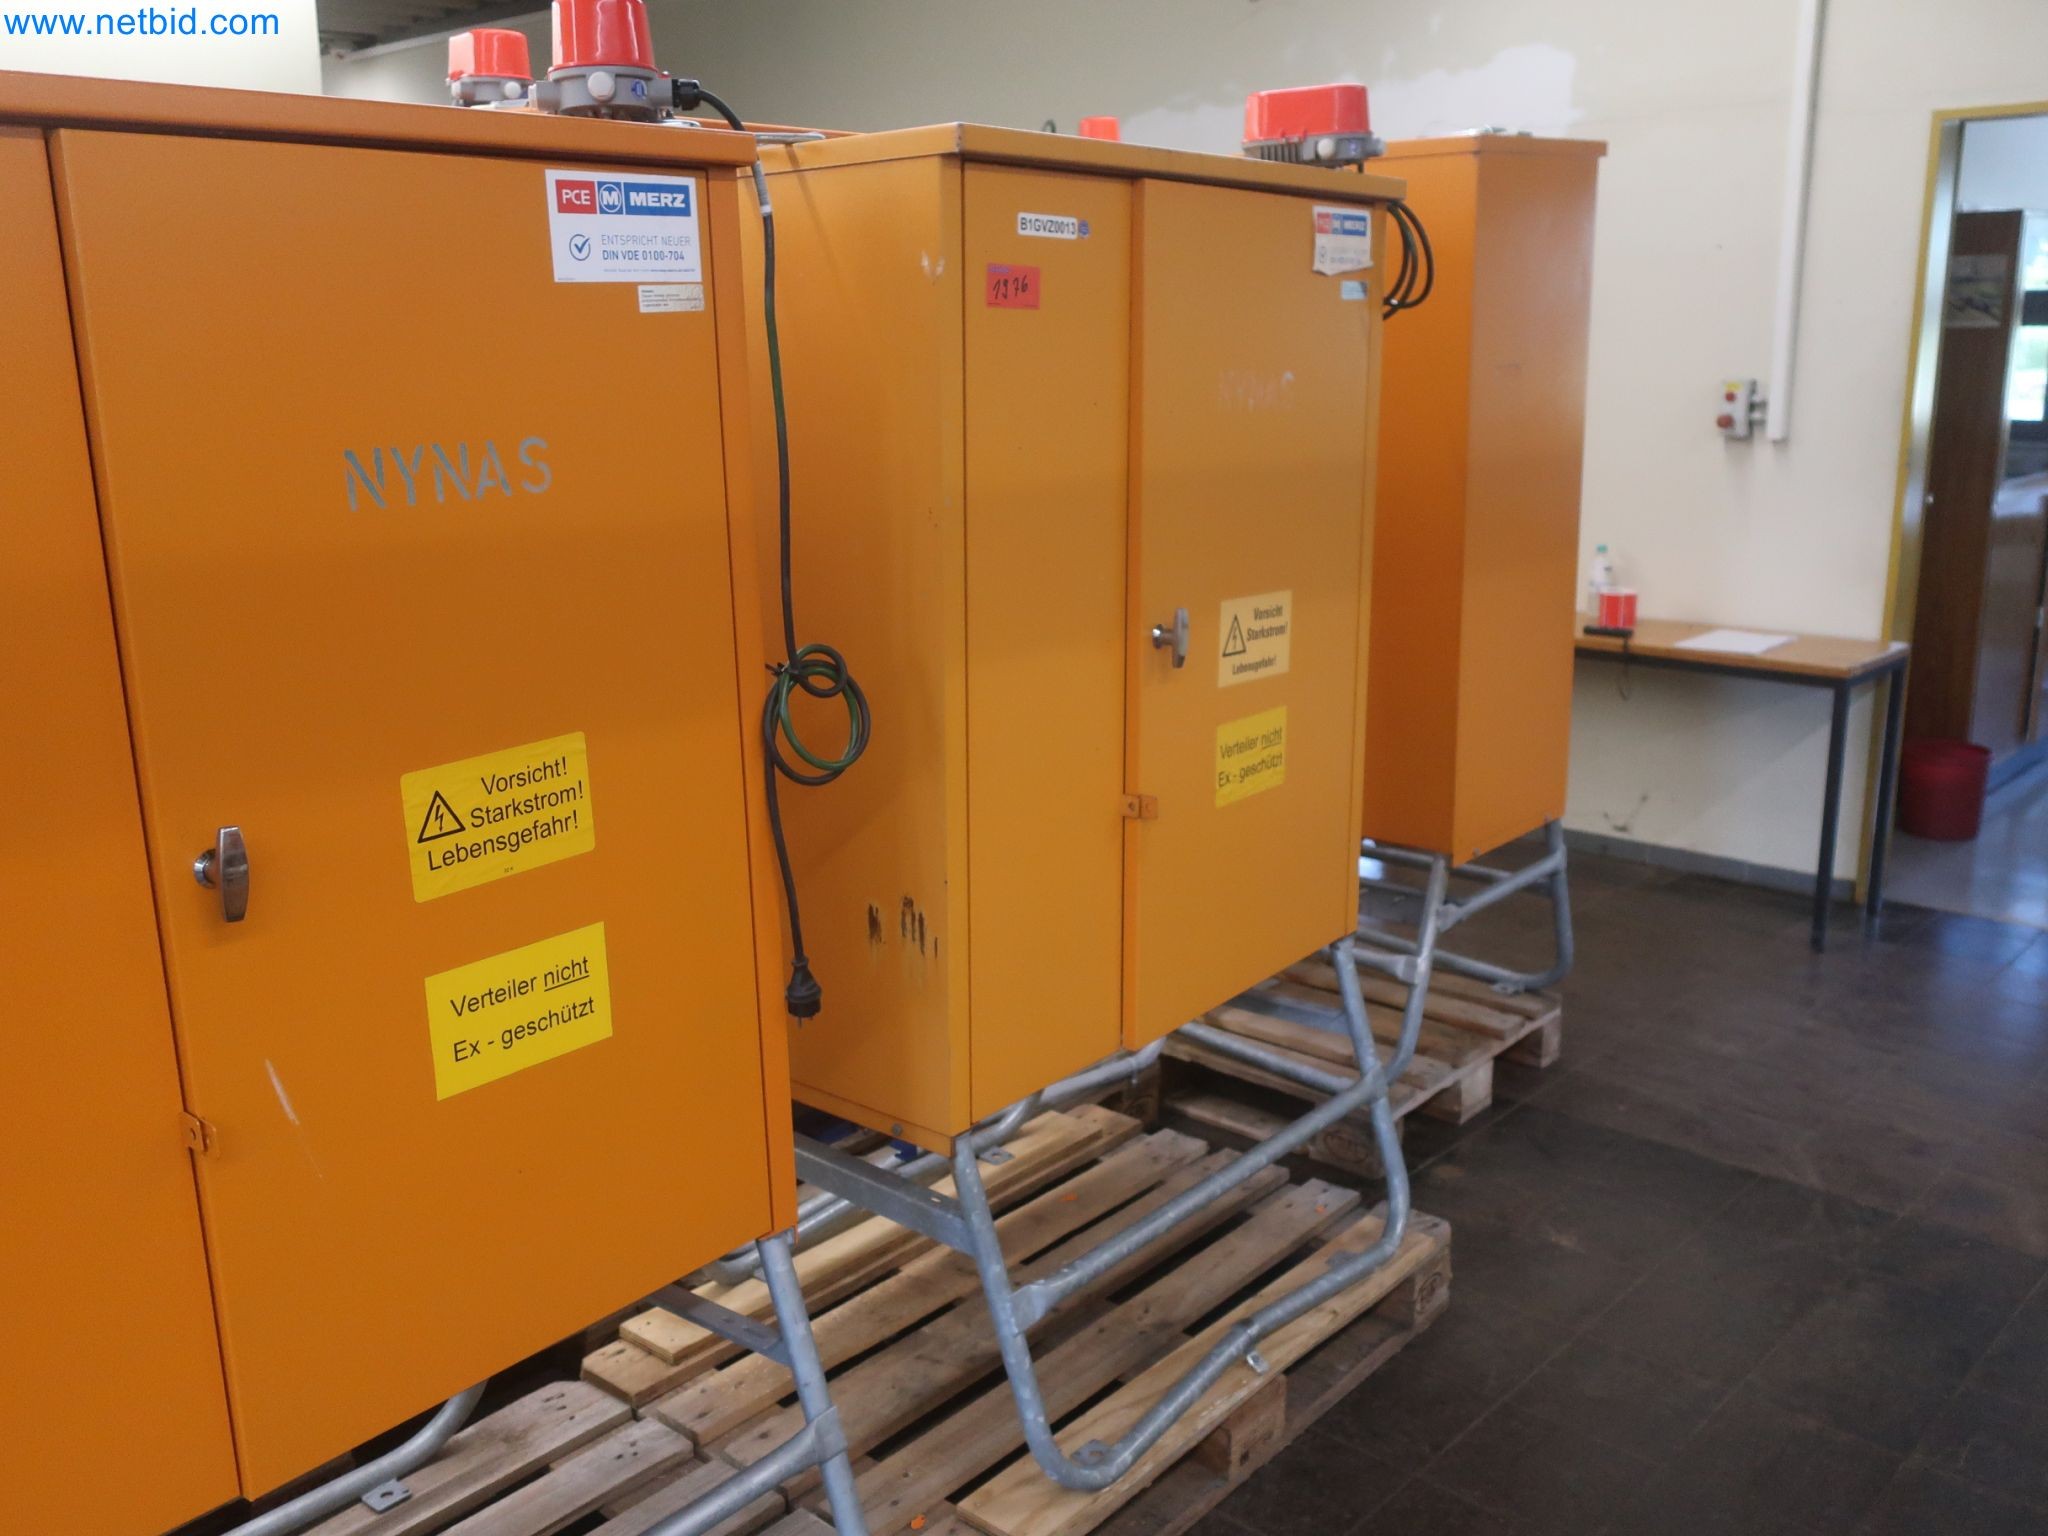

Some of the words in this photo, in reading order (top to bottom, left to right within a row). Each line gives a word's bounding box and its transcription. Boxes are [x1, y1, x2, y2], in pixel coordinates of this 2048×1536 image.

[562, 188, 592, 205] PCE
[629, 191, 686, 208] MERZ
[601, 234, 658, 247] ENTSPRICHT
[661, 236, 691, 247] NEUER
[1020, 216, 1076, 235] B1GVZ0013
[602, 250, 620, 261] DIN
[622, 250, 640, 261] VDE
[642, 250, 686, 262] 0100-704
[343, 436, 553, 513] NYNAS
[481, 756, 568, 796] Vorsicht!
[470, 780, 584, 828] Starkstrom!
[428, 810, 579, 871] Lebensgefahr!
[450, 976, 538, 1017] Verteiler
[543, 956, 590, 992] nicht
[453, 1040, 481, 1063] Ex
[501, 997, 595, 1049] geschützt
